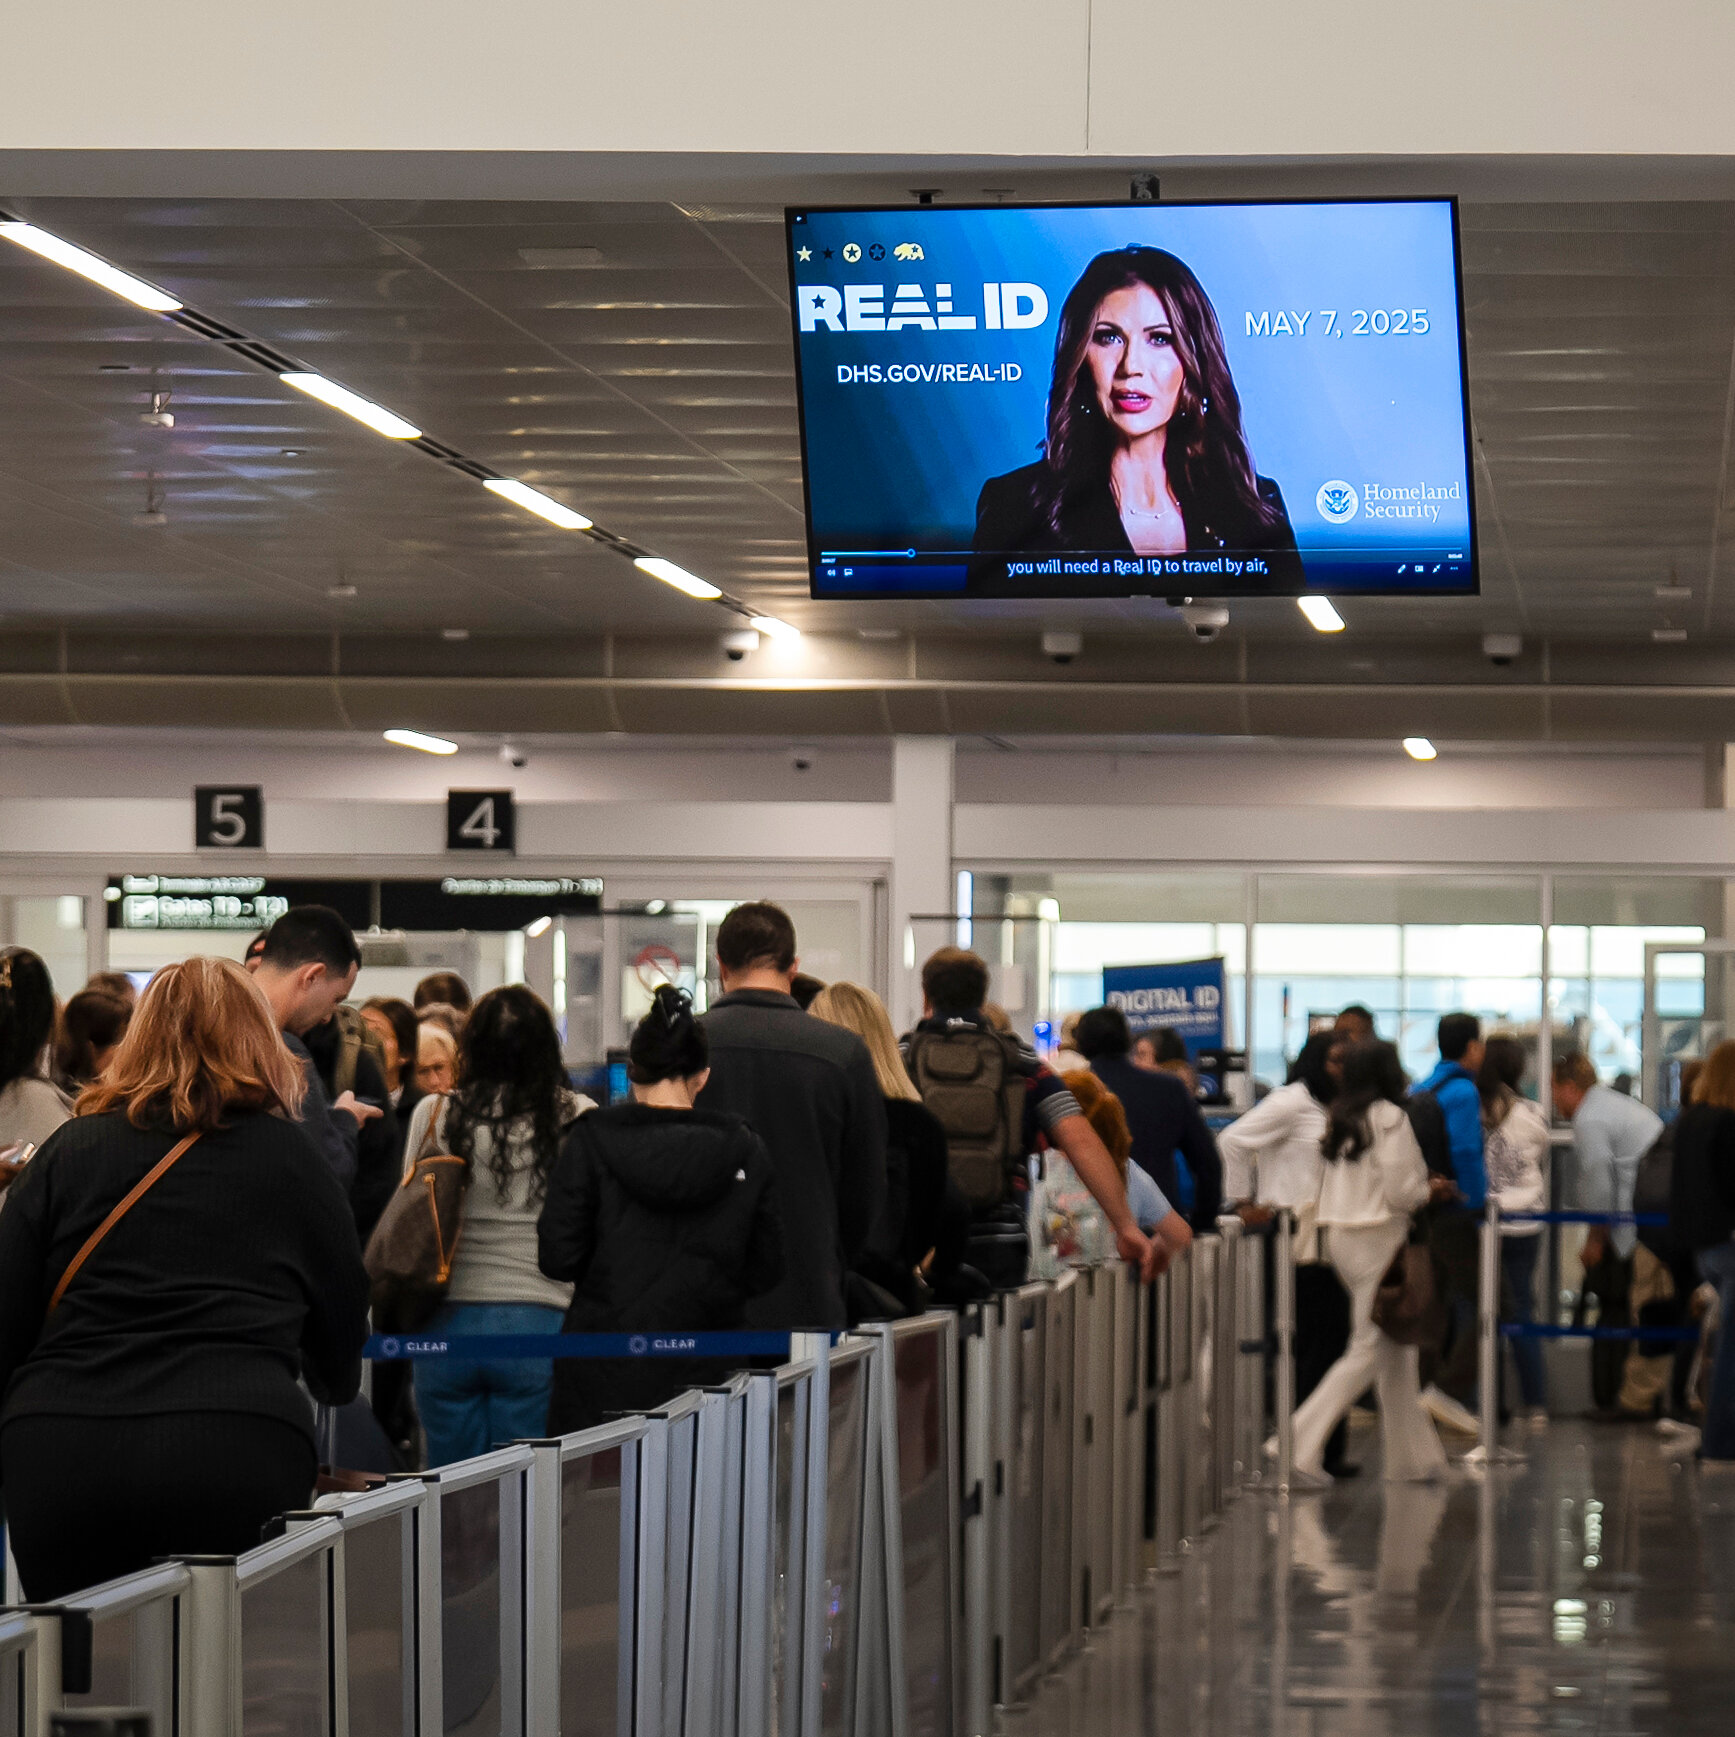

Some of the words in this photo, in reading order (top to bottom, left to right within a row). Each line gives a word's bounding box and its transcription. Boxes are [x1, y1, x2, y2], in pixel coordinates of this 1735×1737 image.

[797, 283, 977, 332] REAL
[983, 282, 1049, 330] ID
[1245, 310, 1312, 336] MAY
[1319, 310, 1343, 339] 7,
[1351, 308, 1430, 335] 2025
[837, 363, 1023, 384] DHS.GOV/REAL-ID
[1363, 481, 1461, 501] Homeland
[1364, 500, 1441, 524] Security
[1006, 562, 1034, 578] you
[1036, 558, 1062, 574] will
[1064, 558, 1099, 574] need
[1102, 561, 1111, 573] a
[1113, 558, 1144, 575] Real
[1147, 559, 1162, 575] ID
[1164, 559, 1180, 573] to
[1182, 557, 1223, 573] travel
[1225, 557, 1244, 576] by
[1246, 557, 1269, 575] air,
[210, 794, 246, 846] 5
[460, 797, 501, 847] 4
[1106, 987, 1193, 1011] DIGITAL
[1193, 984, 1220, 1009] ID
[406, 1341, 448, 1352] CLEAR
[654, 1338, 696, 1349] CLEAR
